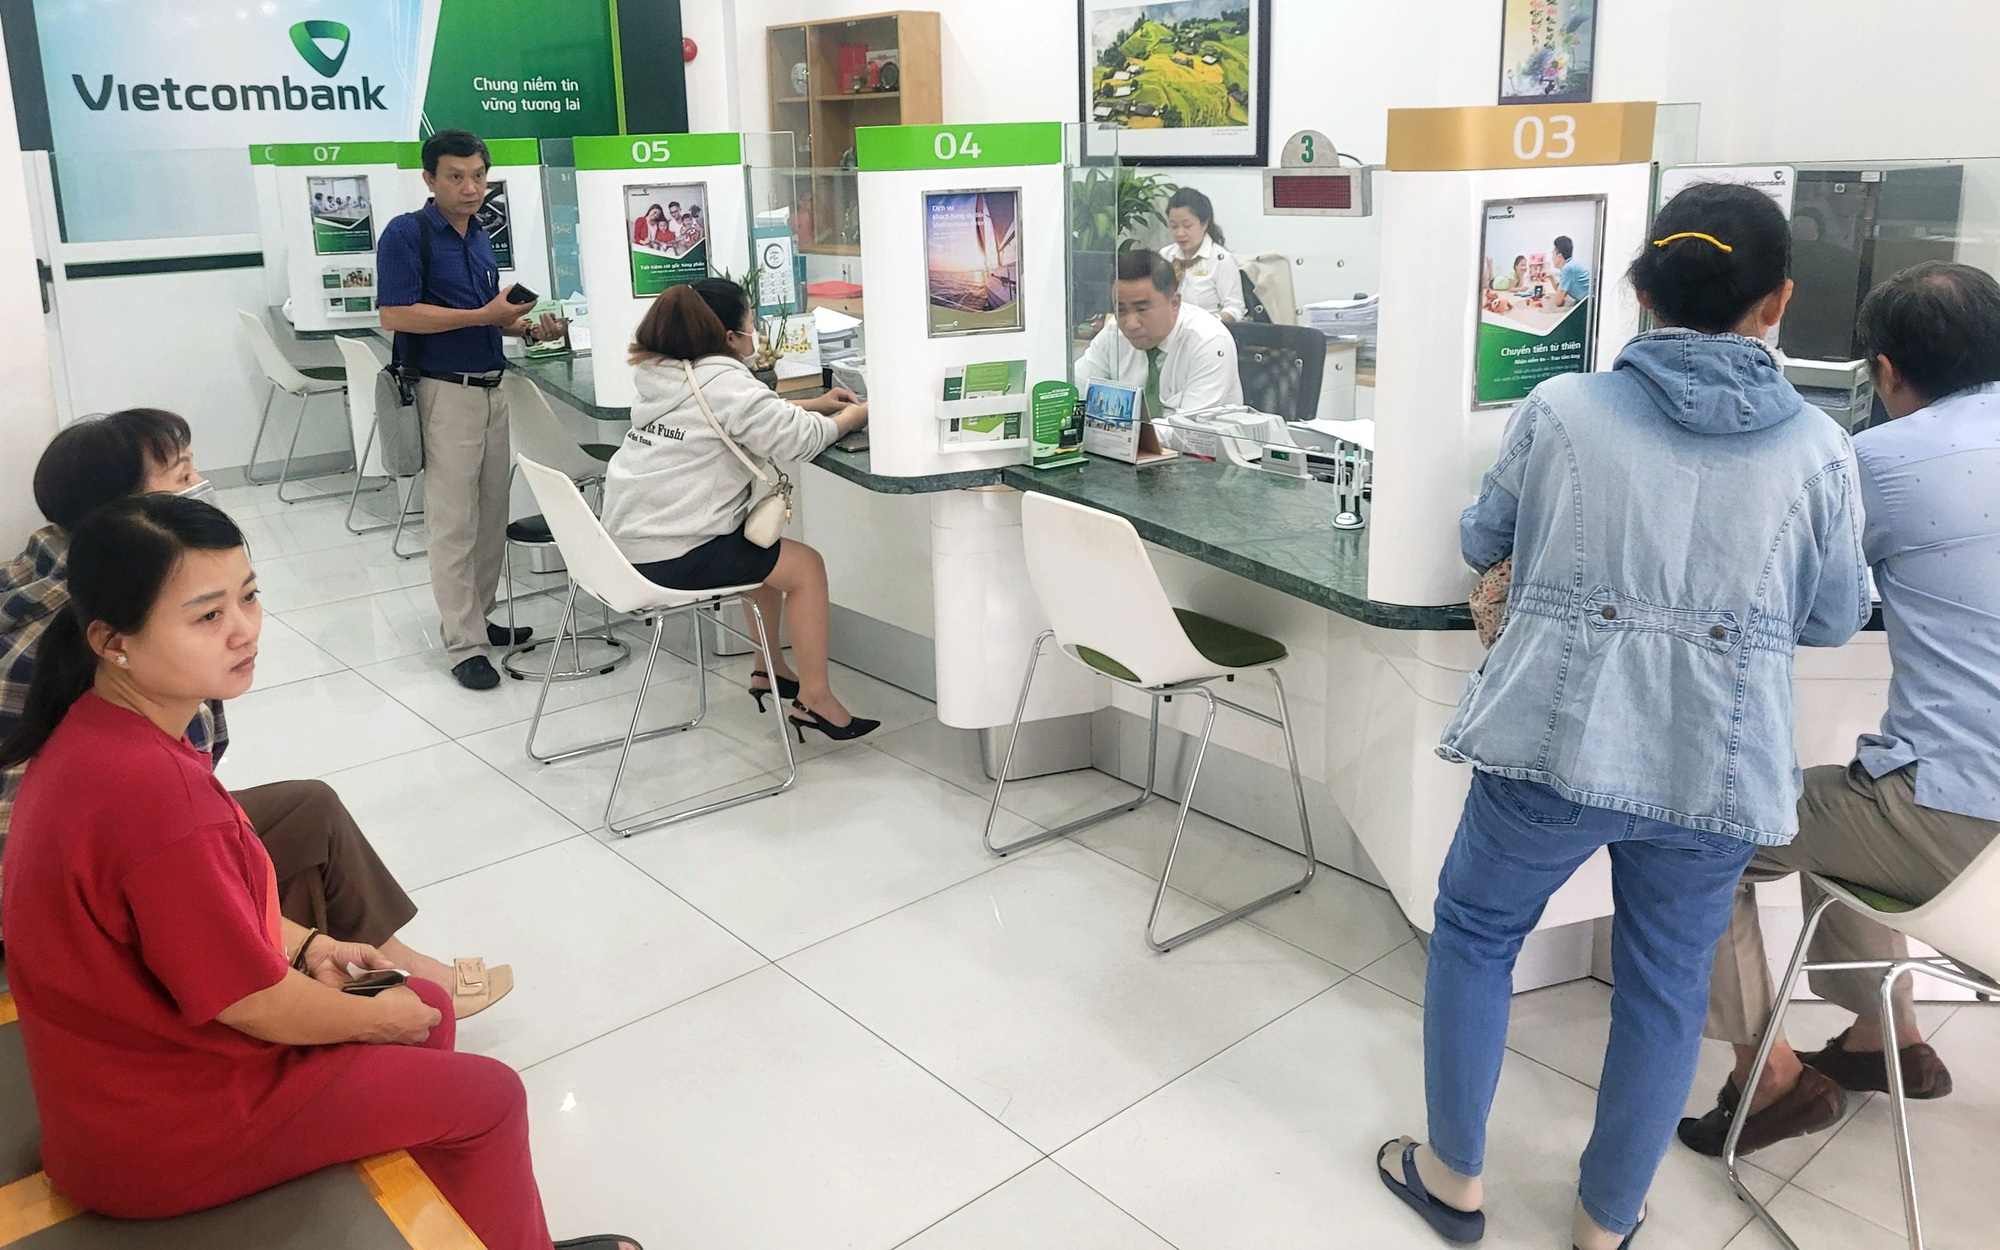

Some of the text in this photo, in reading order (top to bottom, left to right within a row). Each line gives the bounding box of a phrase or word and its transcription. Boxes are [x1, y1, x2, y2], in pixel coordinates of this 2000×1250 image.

[71, 73, 389, 111] Vietcombank
[473, 77, 518, 94] Chung
[561, 78, 579, 91] tin
[481, 97, 517, 114] vững
[565, 97, 580, 111] lai
[934, 131, 982, 160] 04
[1513, 114, 1576, 160] 03
[313, 145, 341, 162] 07
[632, 140, 670, 163] 05
[1301, 135, 1314, 163] 3
[1744, 179, 1787, 187] Vietcombank
[658, 423, 687, 441] Fushi
